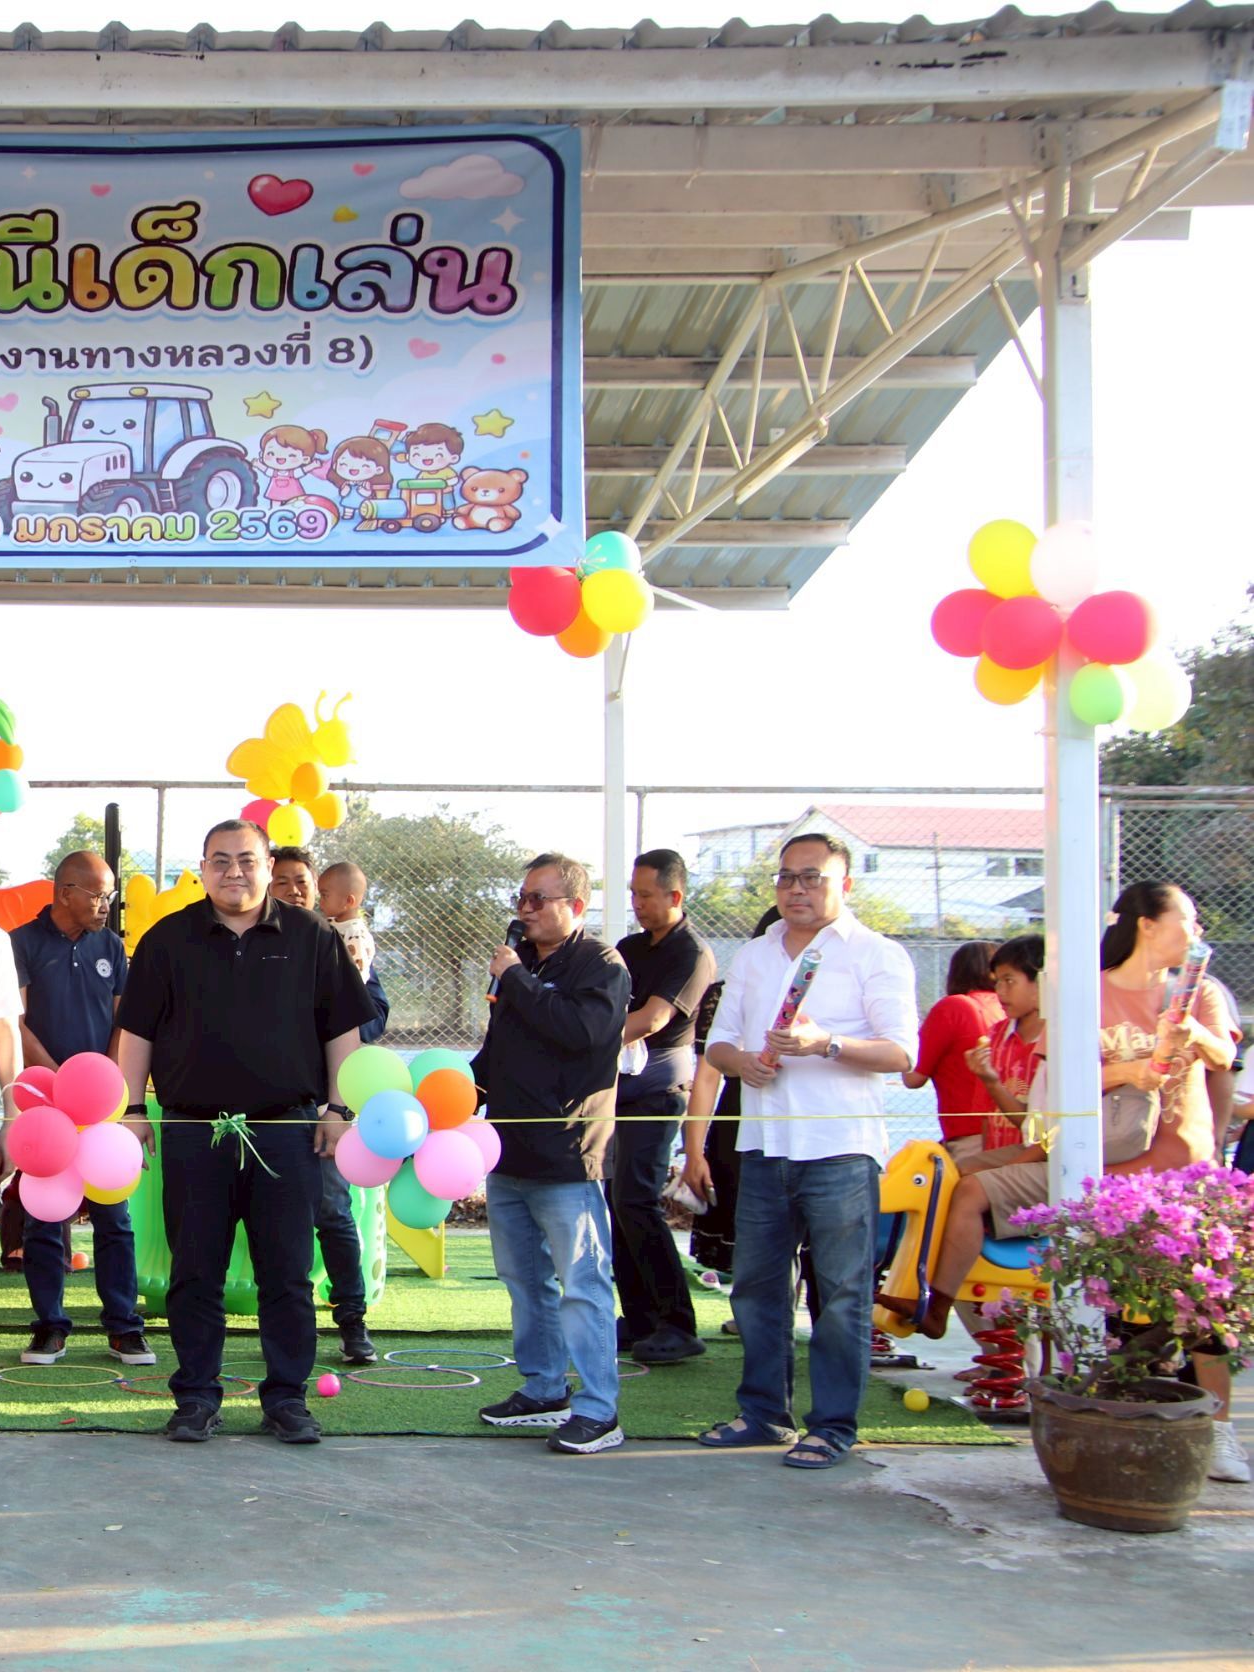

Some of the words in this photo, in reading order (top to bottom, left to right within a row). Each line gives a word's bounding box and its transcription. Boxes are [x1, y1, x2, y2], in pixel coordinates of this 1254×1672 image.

[327, 334, 375, 370] 8)
[14, 514, 195, 545] มกราคม
[209, 512, 329, 542] 2569
